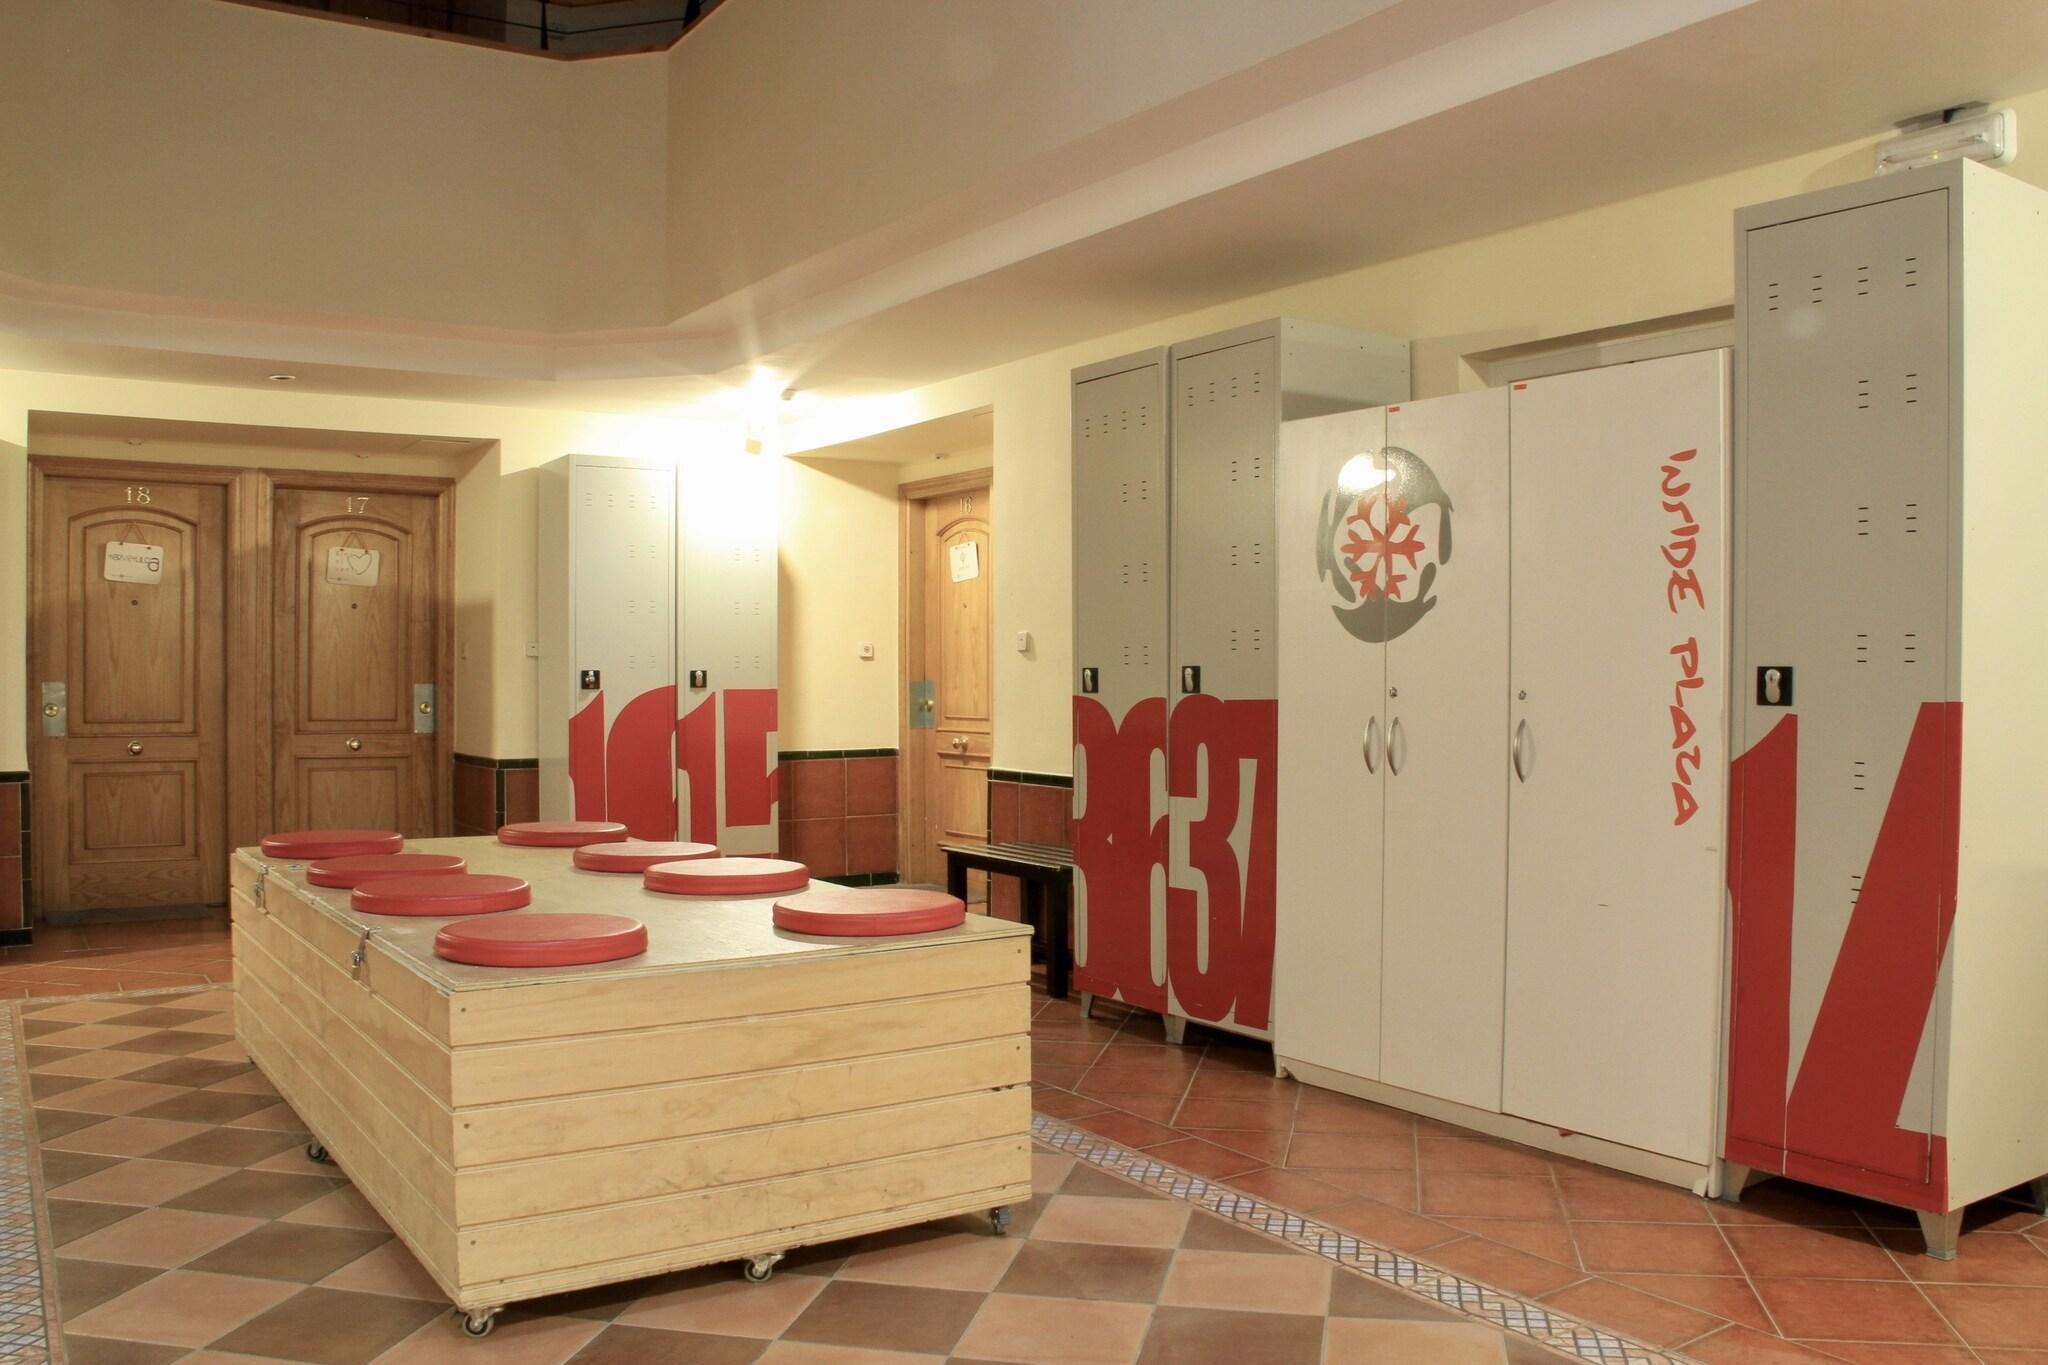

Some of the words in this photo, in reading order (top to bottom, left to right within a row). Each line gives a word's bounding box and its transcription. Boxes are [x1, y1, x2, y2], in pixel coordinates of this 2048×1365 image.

[124, 486, 151, 505] 18
[345, 496, 370, 514] 17
[959, 496, 973, 514] 16
[1661, 448, 1705, 614] INSIDE
[1670, 636, 1705, 827] PLAZA
